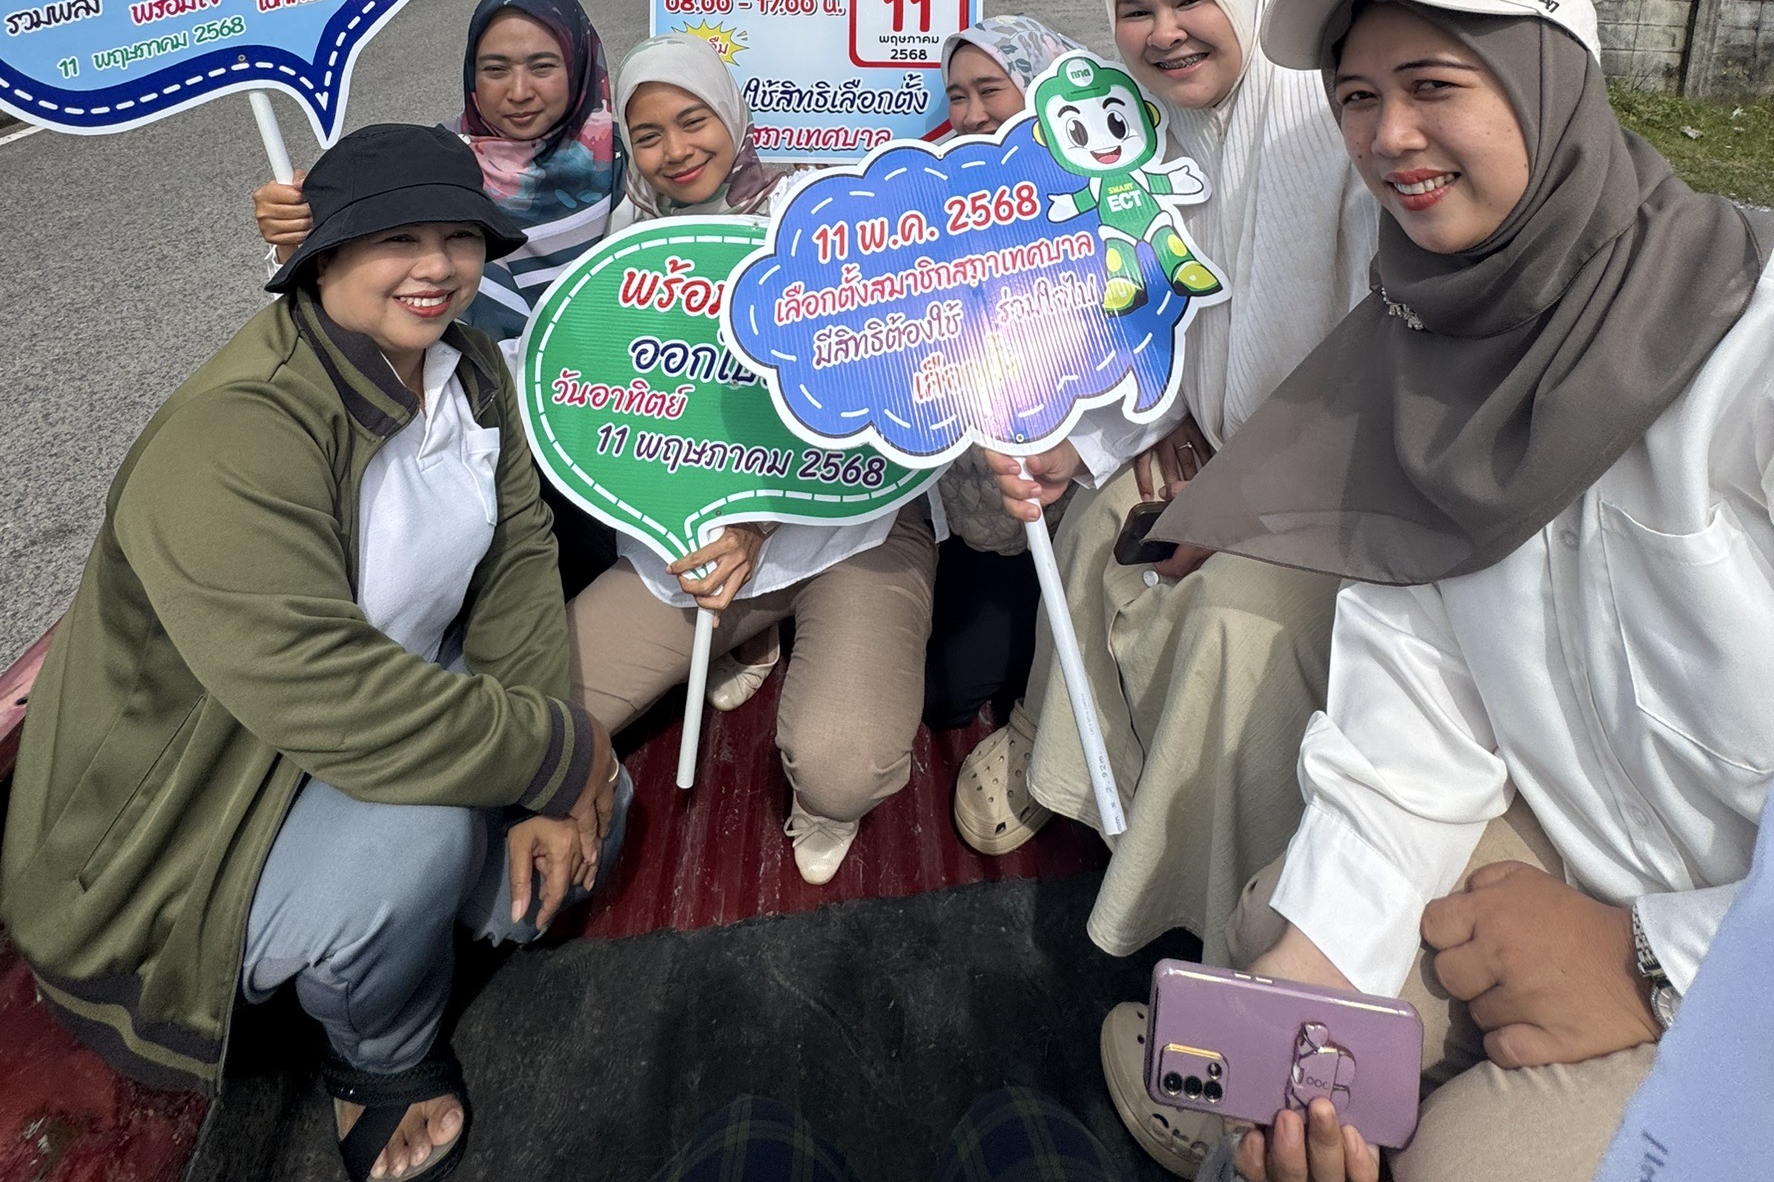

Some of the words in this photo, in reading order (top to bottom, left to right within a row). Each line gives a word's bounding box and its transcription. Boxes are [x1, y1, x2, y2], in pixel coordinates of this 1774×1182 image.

[59, 57, 78, 77] 11
[93, 32, 188, 69] พฤษภาคม
[194, 16, 244, 43] 2568
[879, 34, 940, 46] พฤษภาคม
[890, 48, 928, 61] 2568
[743, 74, 928, 111] ใช้สิทธิเลือกตั้ง
[1106, 190, 1142, 213] ECT
[1107, 183, 1134, 195] SMART
[816, 227, 845, 261] 11
[859, 213, 936, 251] พ.ค.
[947, 185, 1038, 233] 2568
[776, 234, 1093, 322] เลือกตั้งสมาชิกสภาเทศบาล
[815, 302, 960, 366] มีสิทธิต้องใช้
[553, 370, 693, 418] วันอาทิตย์
[599, 425, 628, 454] 11
[636, 432, 792, 473] พฤษภาคม
[799, 450, 885, 487] 2568
